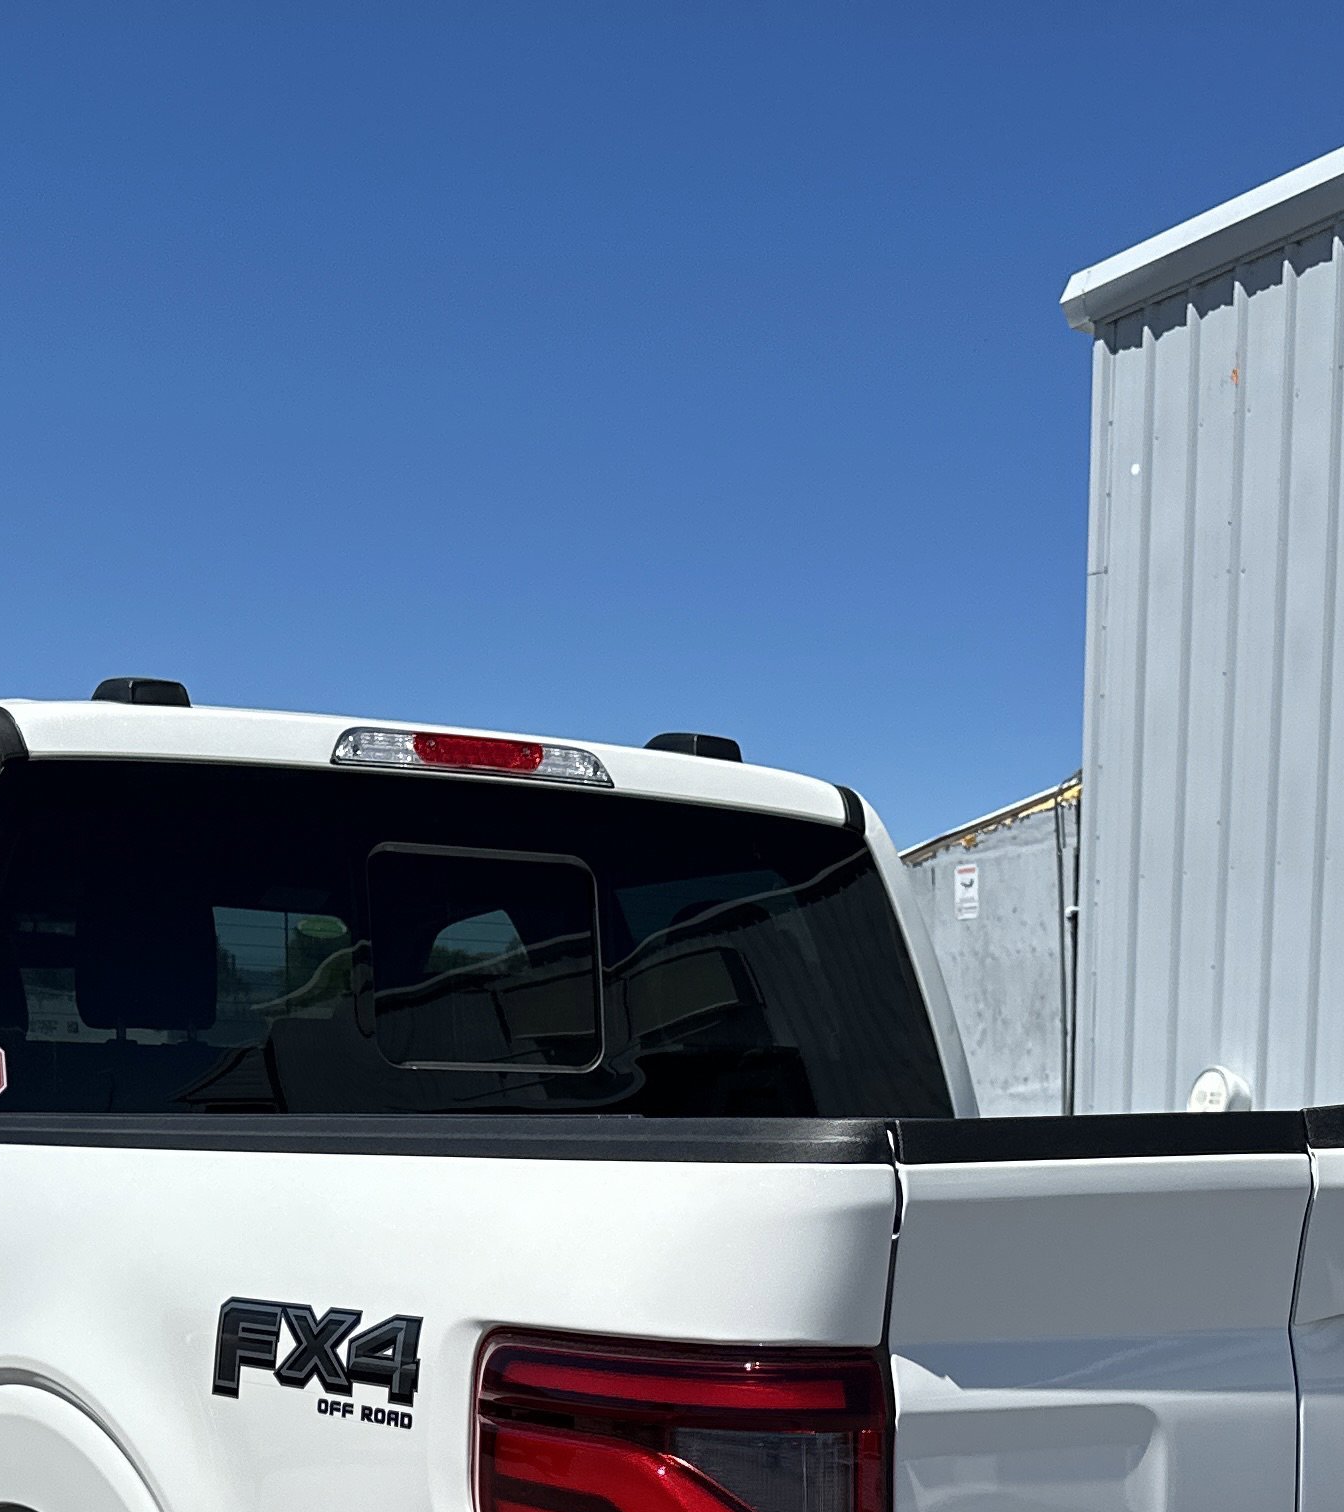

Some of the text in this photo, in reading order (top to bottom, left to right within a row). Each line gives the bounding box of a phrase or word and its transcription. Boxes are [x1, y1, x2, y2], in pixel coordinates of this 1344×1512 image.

[212, 1296, 424, 1407] FX4
[317, 1398, 413, 1430] OFF ROAD
